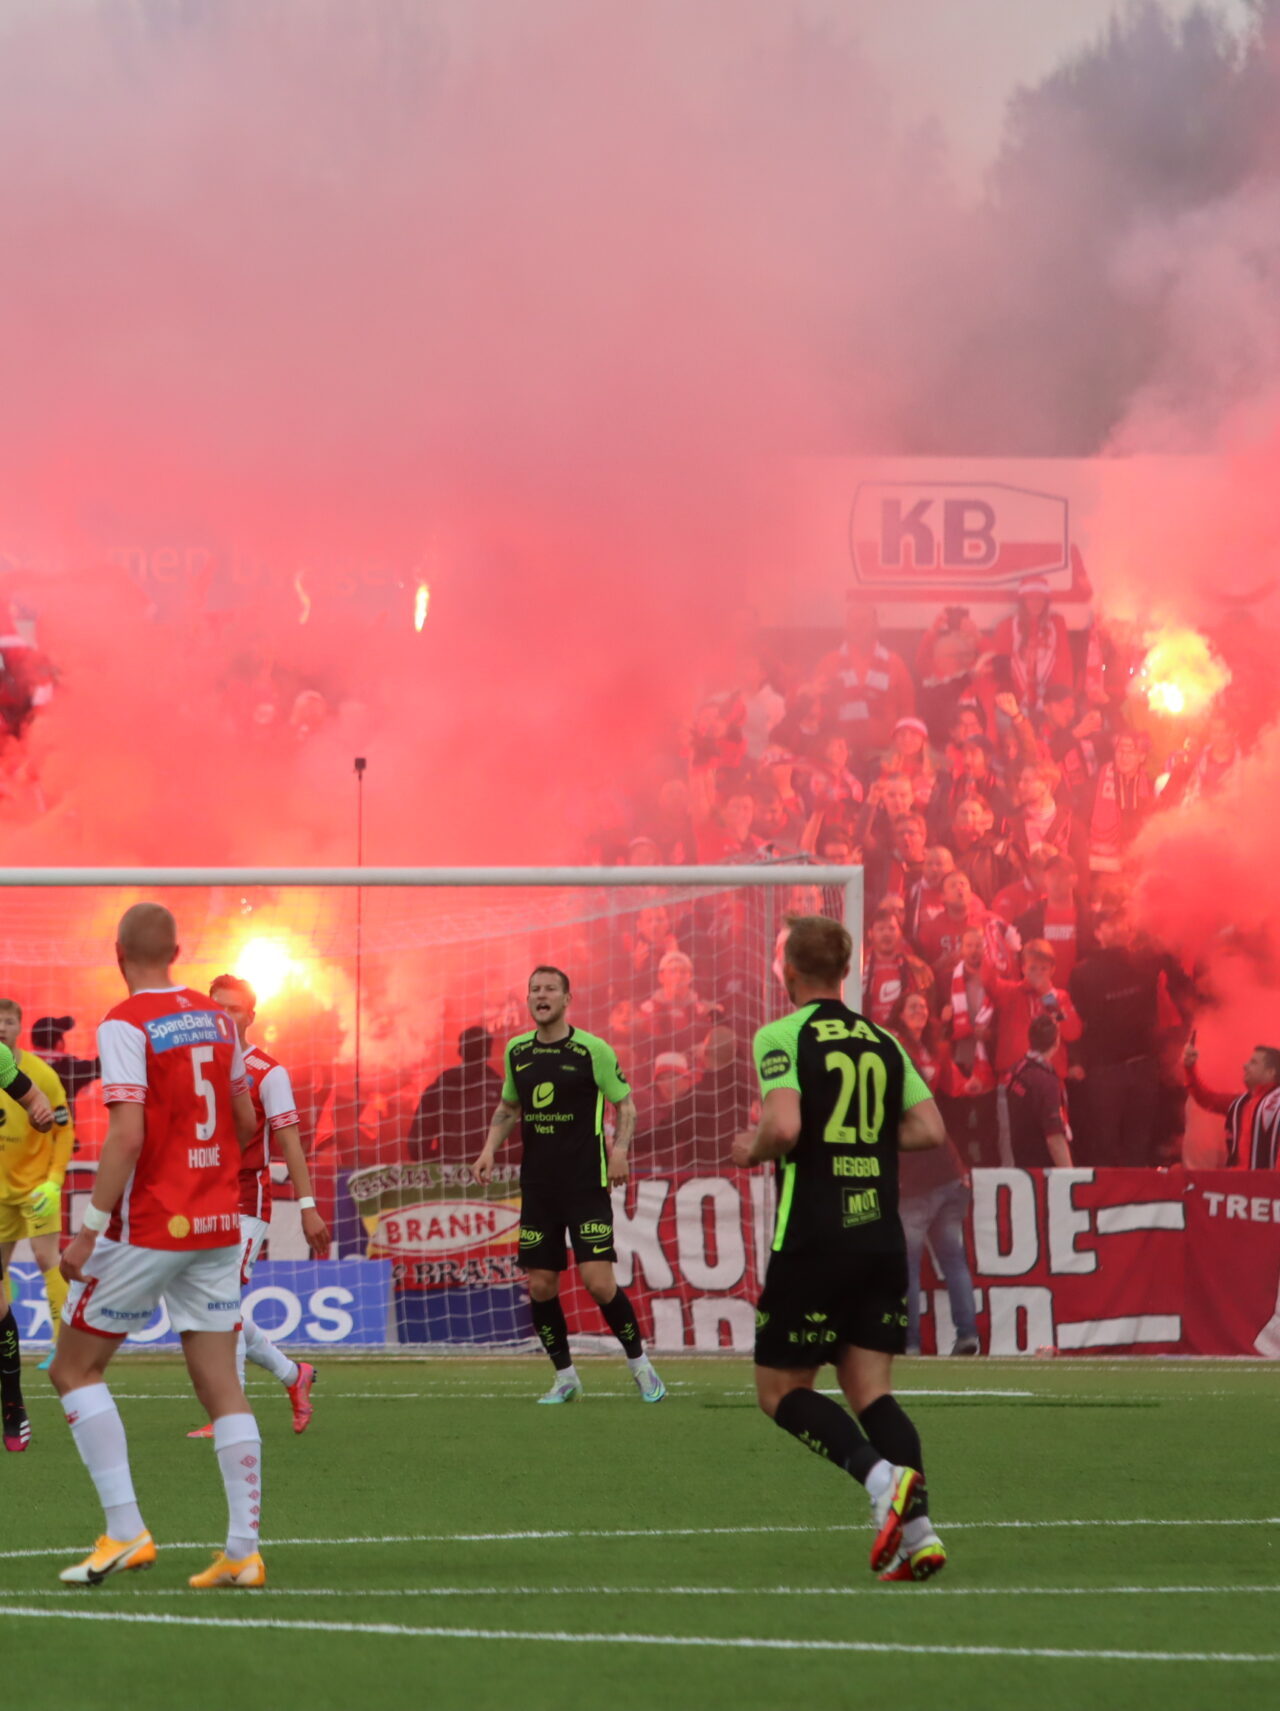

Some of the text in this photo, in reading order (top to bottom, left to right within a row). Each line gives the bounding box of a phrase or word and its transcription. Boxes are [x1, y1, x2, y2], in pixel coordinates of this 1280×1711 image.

[879, 498, 998, 566] KB
[147, 1013, 228, 1040] SpareBank 1
[810, 1018, 881, 1043] BA
[191, 1045, 217, 1141] 5
[823, 1051, 888, 1144] 20
[534, 1123, 555, 1135] Vest
[194, 1215, 218, 1235] RIGHT
[220, 1214, 231, 1231] TO
[385, 1209, 498, 1246] BRANN
